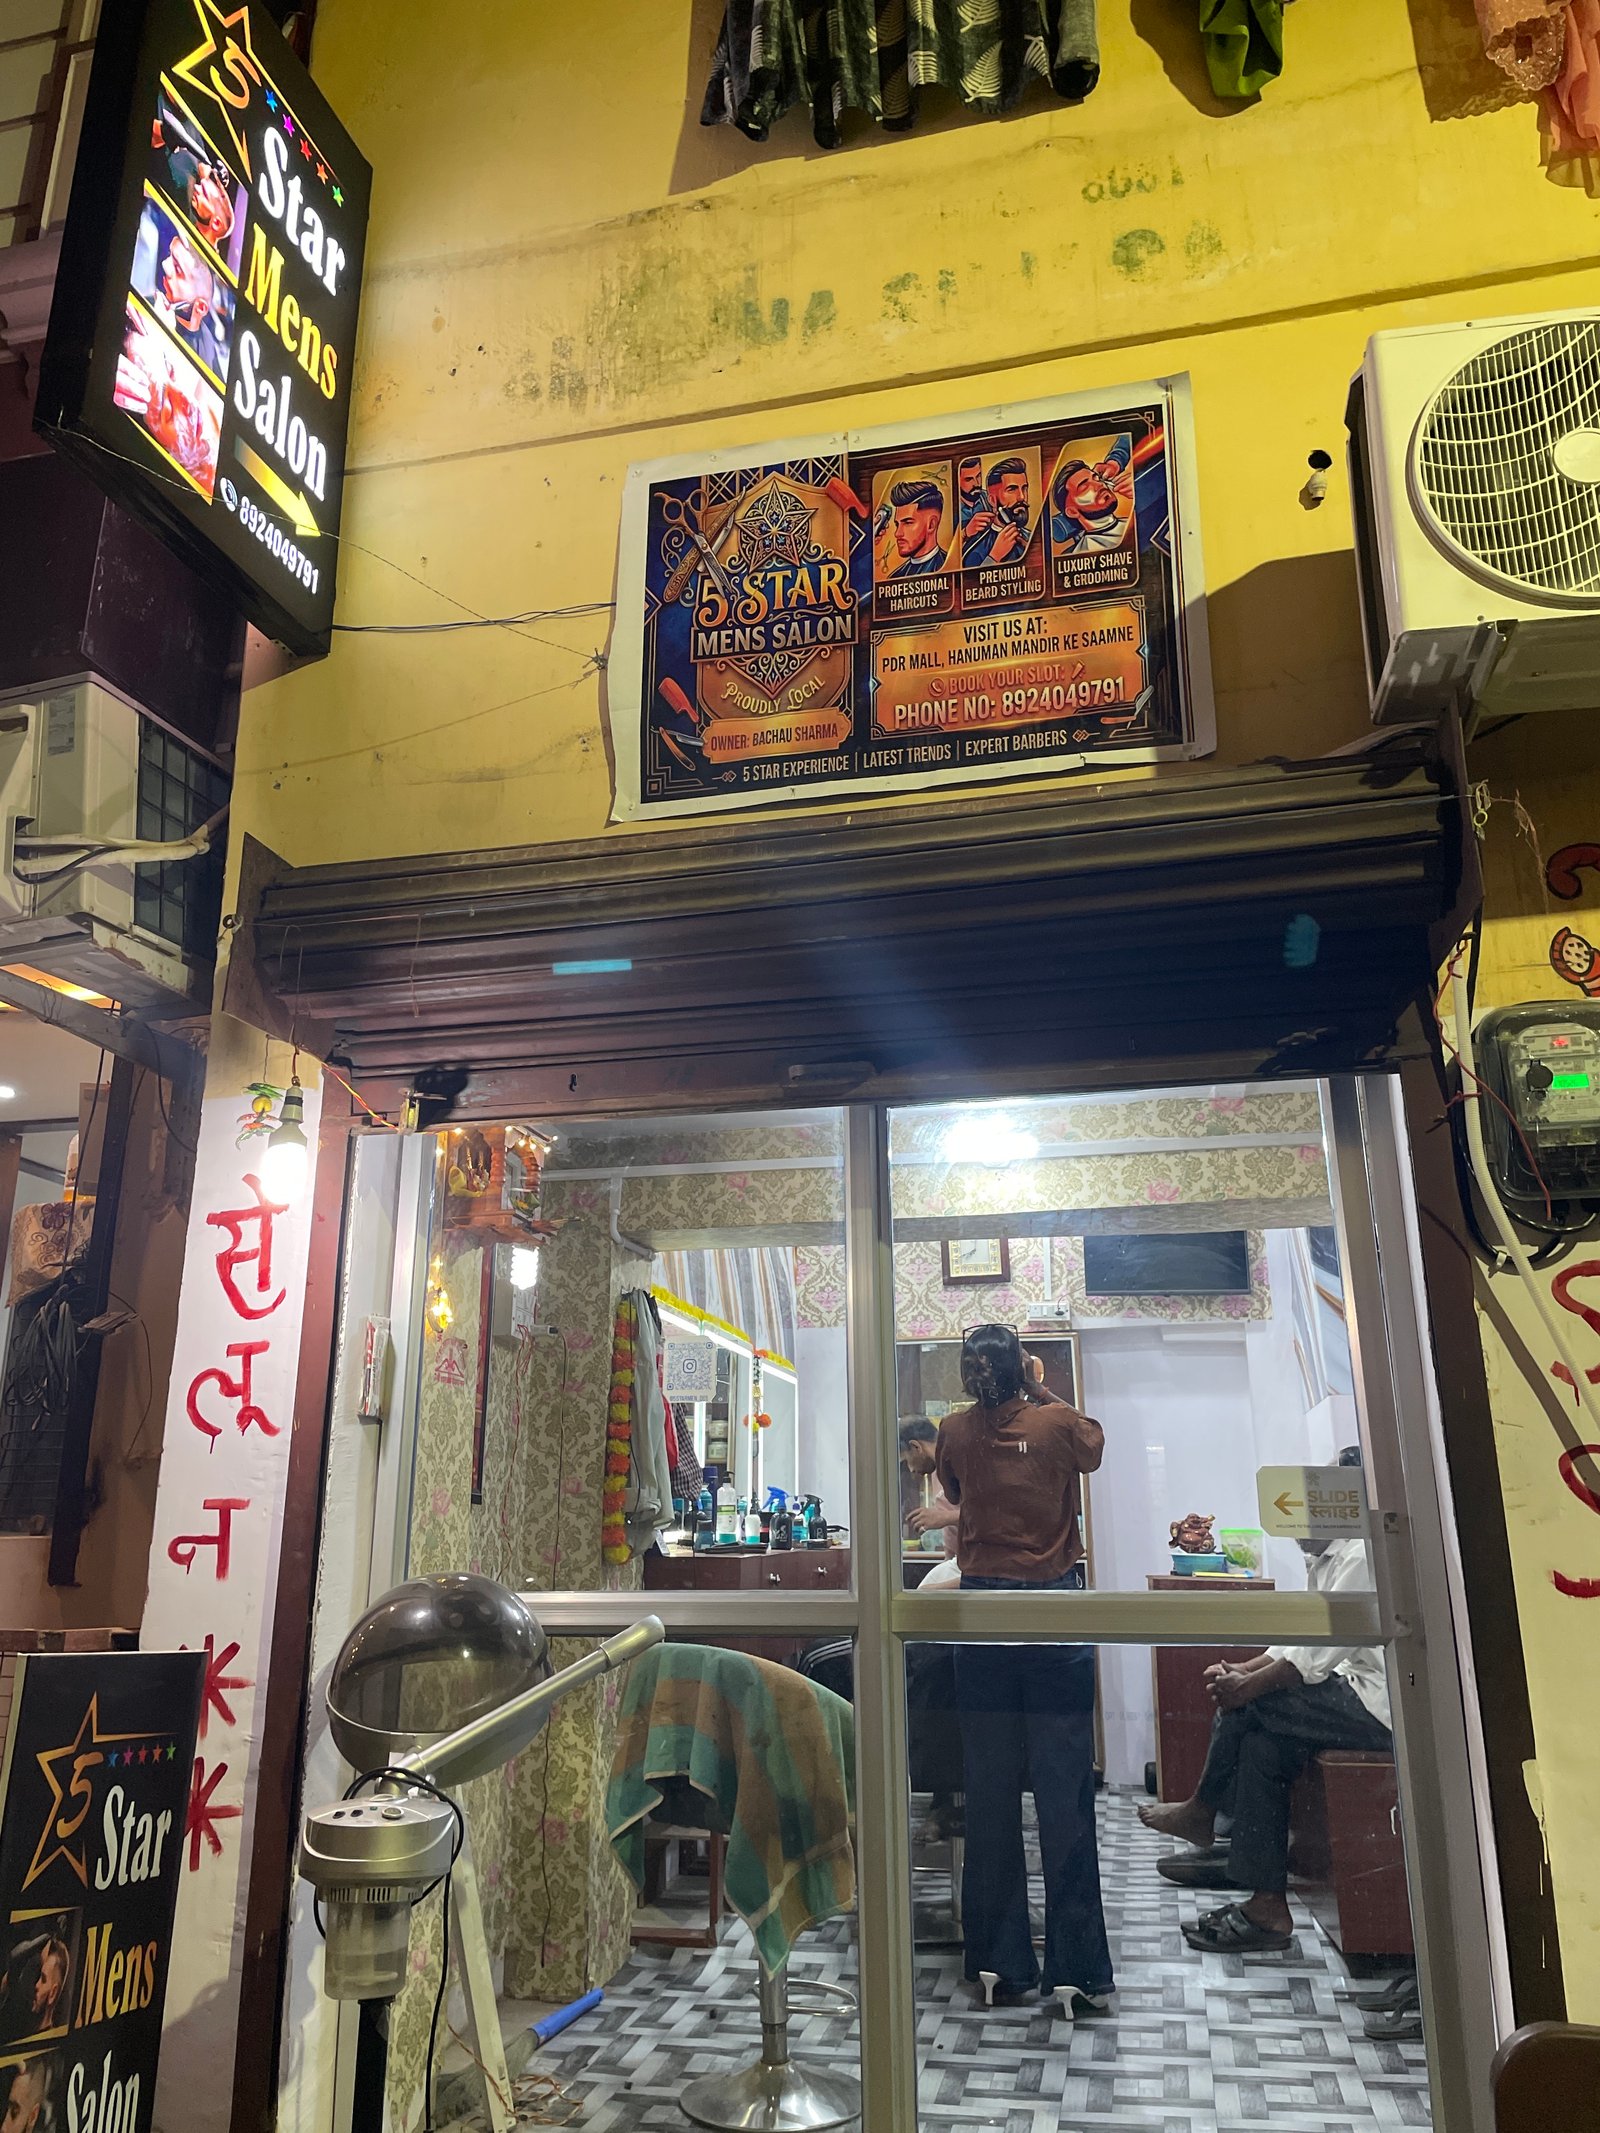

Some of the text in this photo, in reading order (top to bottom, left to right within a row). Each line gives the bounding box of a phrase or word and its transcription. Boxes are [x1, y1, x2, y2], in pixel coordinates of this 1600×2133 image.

[210, 36, 262, 109] 5
[258, 126, 346, 296] Star
[245, 222, 338, 400] Mens
[234, 330, 328, 502] Salon
[239, 495, 319, 595] 8924049791
[1057, 551, 1133, 574] LUXURY SHAVE
[699, 562, 852, 628] 5 STAR
[878, 577, 950, 599] PROFESSIONAL
[965, 579, 1042, 602] BEARD STYLING
[979, 565, 1027, 585] PREMIUM
[1063, 567, 1129, 589] & GROOMING
[890, 594, 938, 612] HAIRCUTS
[697, 614, 852, 657] MENS SALON
[882, 626, 1134, 673] PDR MALL, HANUMAN MANDIR KE SAAMNE
[963, 616, 1047, 644] VISIT US AT:
[720, 675, 826, 714] PROUDLY LOCAL
[949, 663, 1065, 694] BOOK YOUR SLOT:
[894, 676, 1126, 729] PHONE NO: 8924049791
[711, 723, 839, 751] OWNER: BACHAU SHARMA
[743, 729, 1068, 782] 5 STAR EXPERIENCE LATEST TRENDS EXPERT BARBERS
[1306, 1490, 1360, 1503] SLIDE
[1308, 1505, 1360, 1520] स्लाइड
[56, 1752, 104, 1839] 5
[94, 1785, 172, 1891] Star
[74, 1922, 157, 2030] Mens
